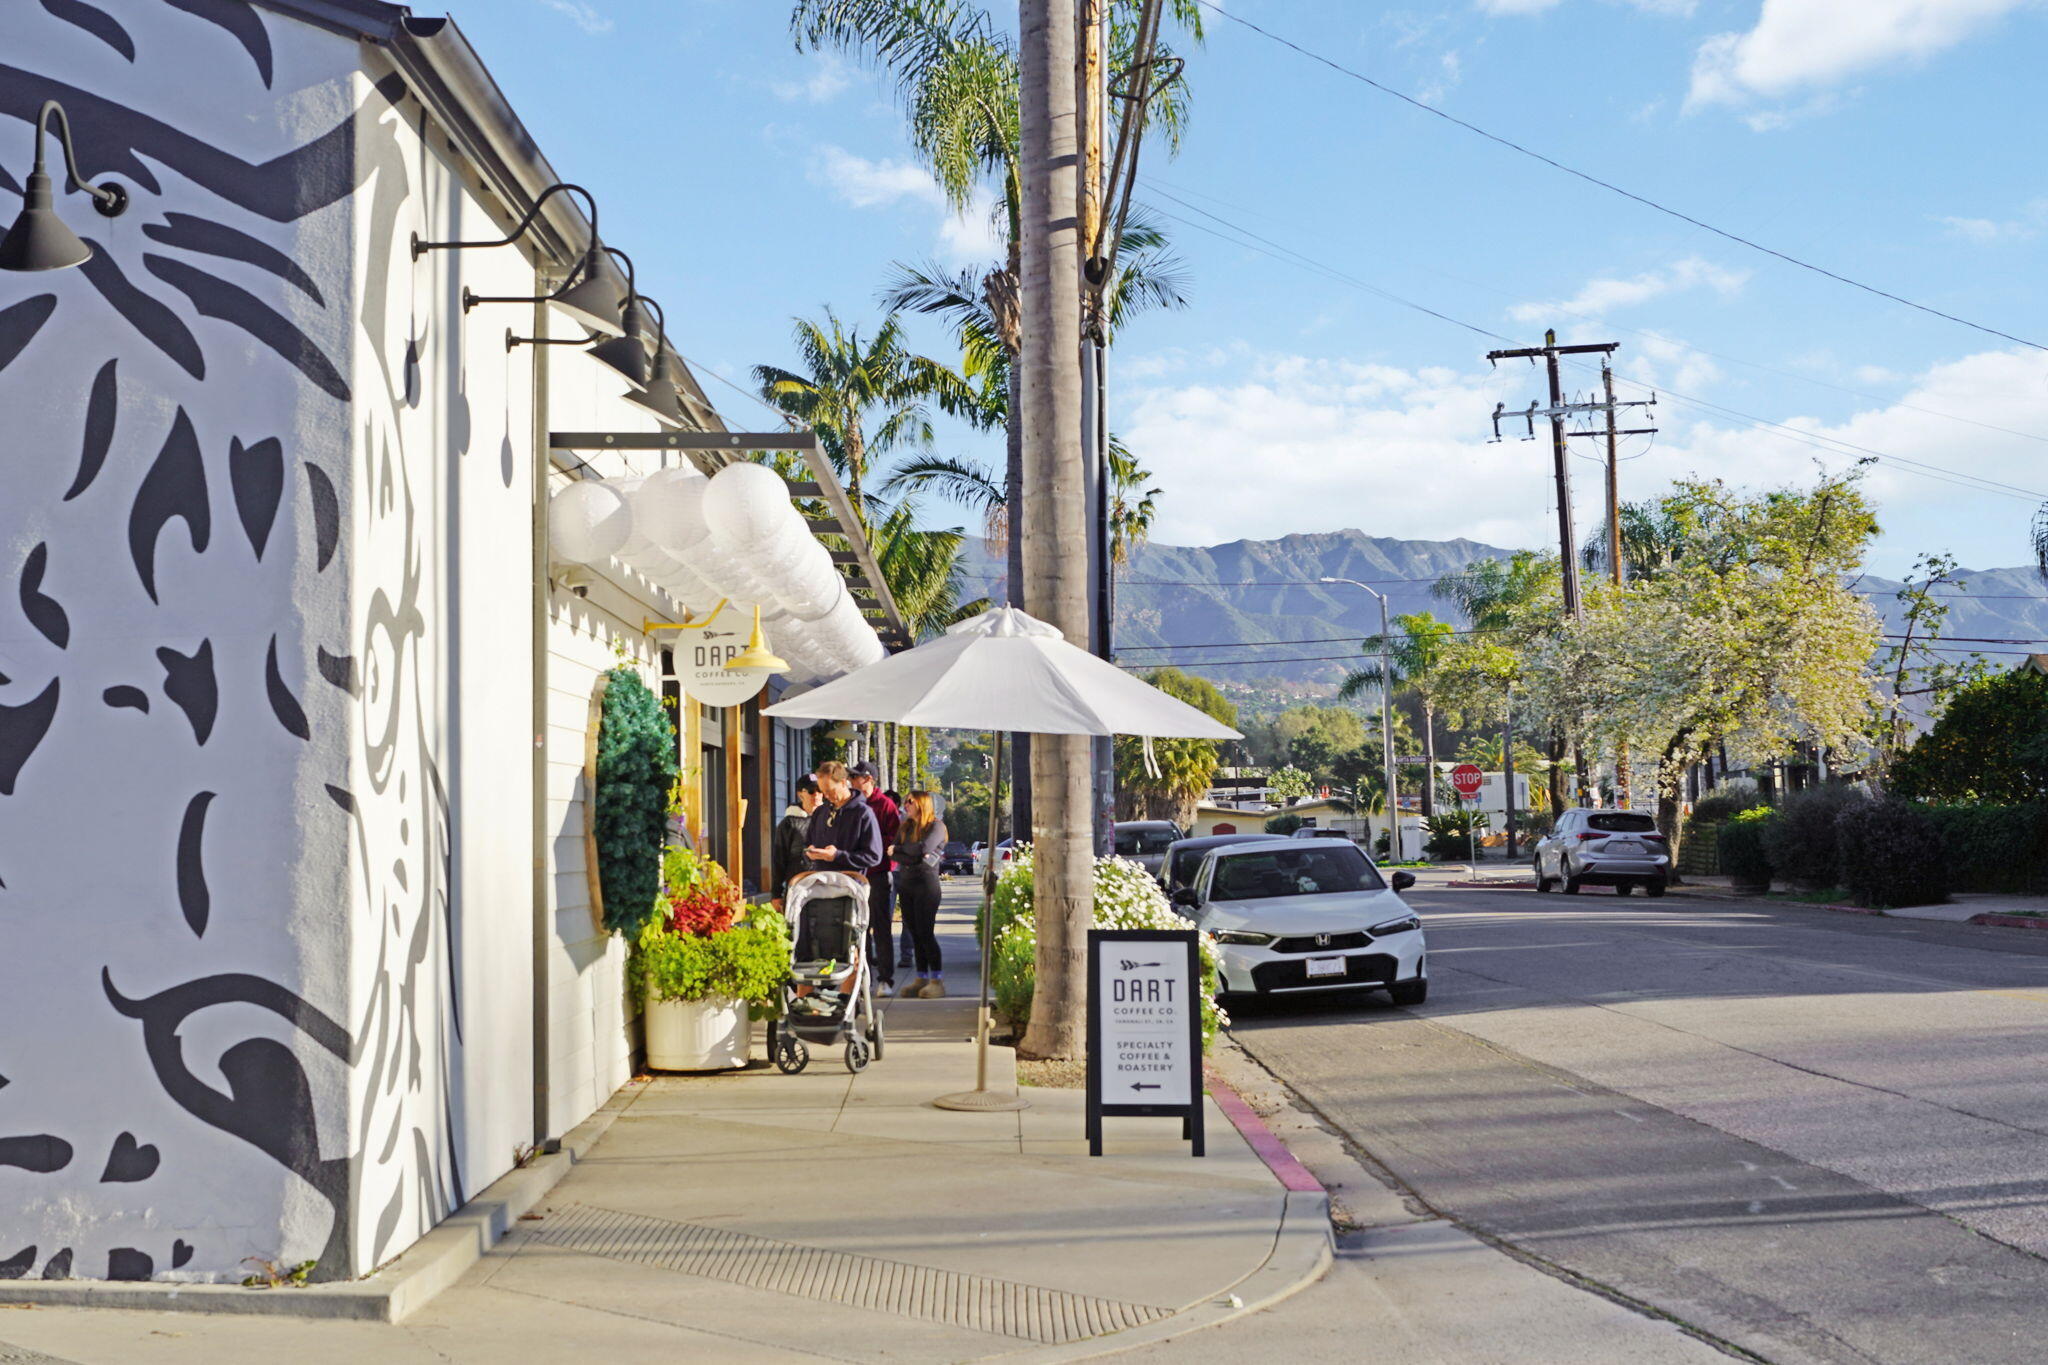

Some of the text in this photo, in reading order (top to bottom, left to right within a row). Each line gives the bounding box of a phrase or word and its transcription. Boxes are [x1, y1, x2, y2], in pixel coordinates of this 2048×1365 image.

[1454, 772, 1480, 785] STOP
[1113, 979, 1175, 1002] DART
[1113, 1007, 1153, 1015] COFFEE
[1116, 1041, 1173, 1049] SPECIALTY
[1119, 1052, 1159, 1060] COFFEE
